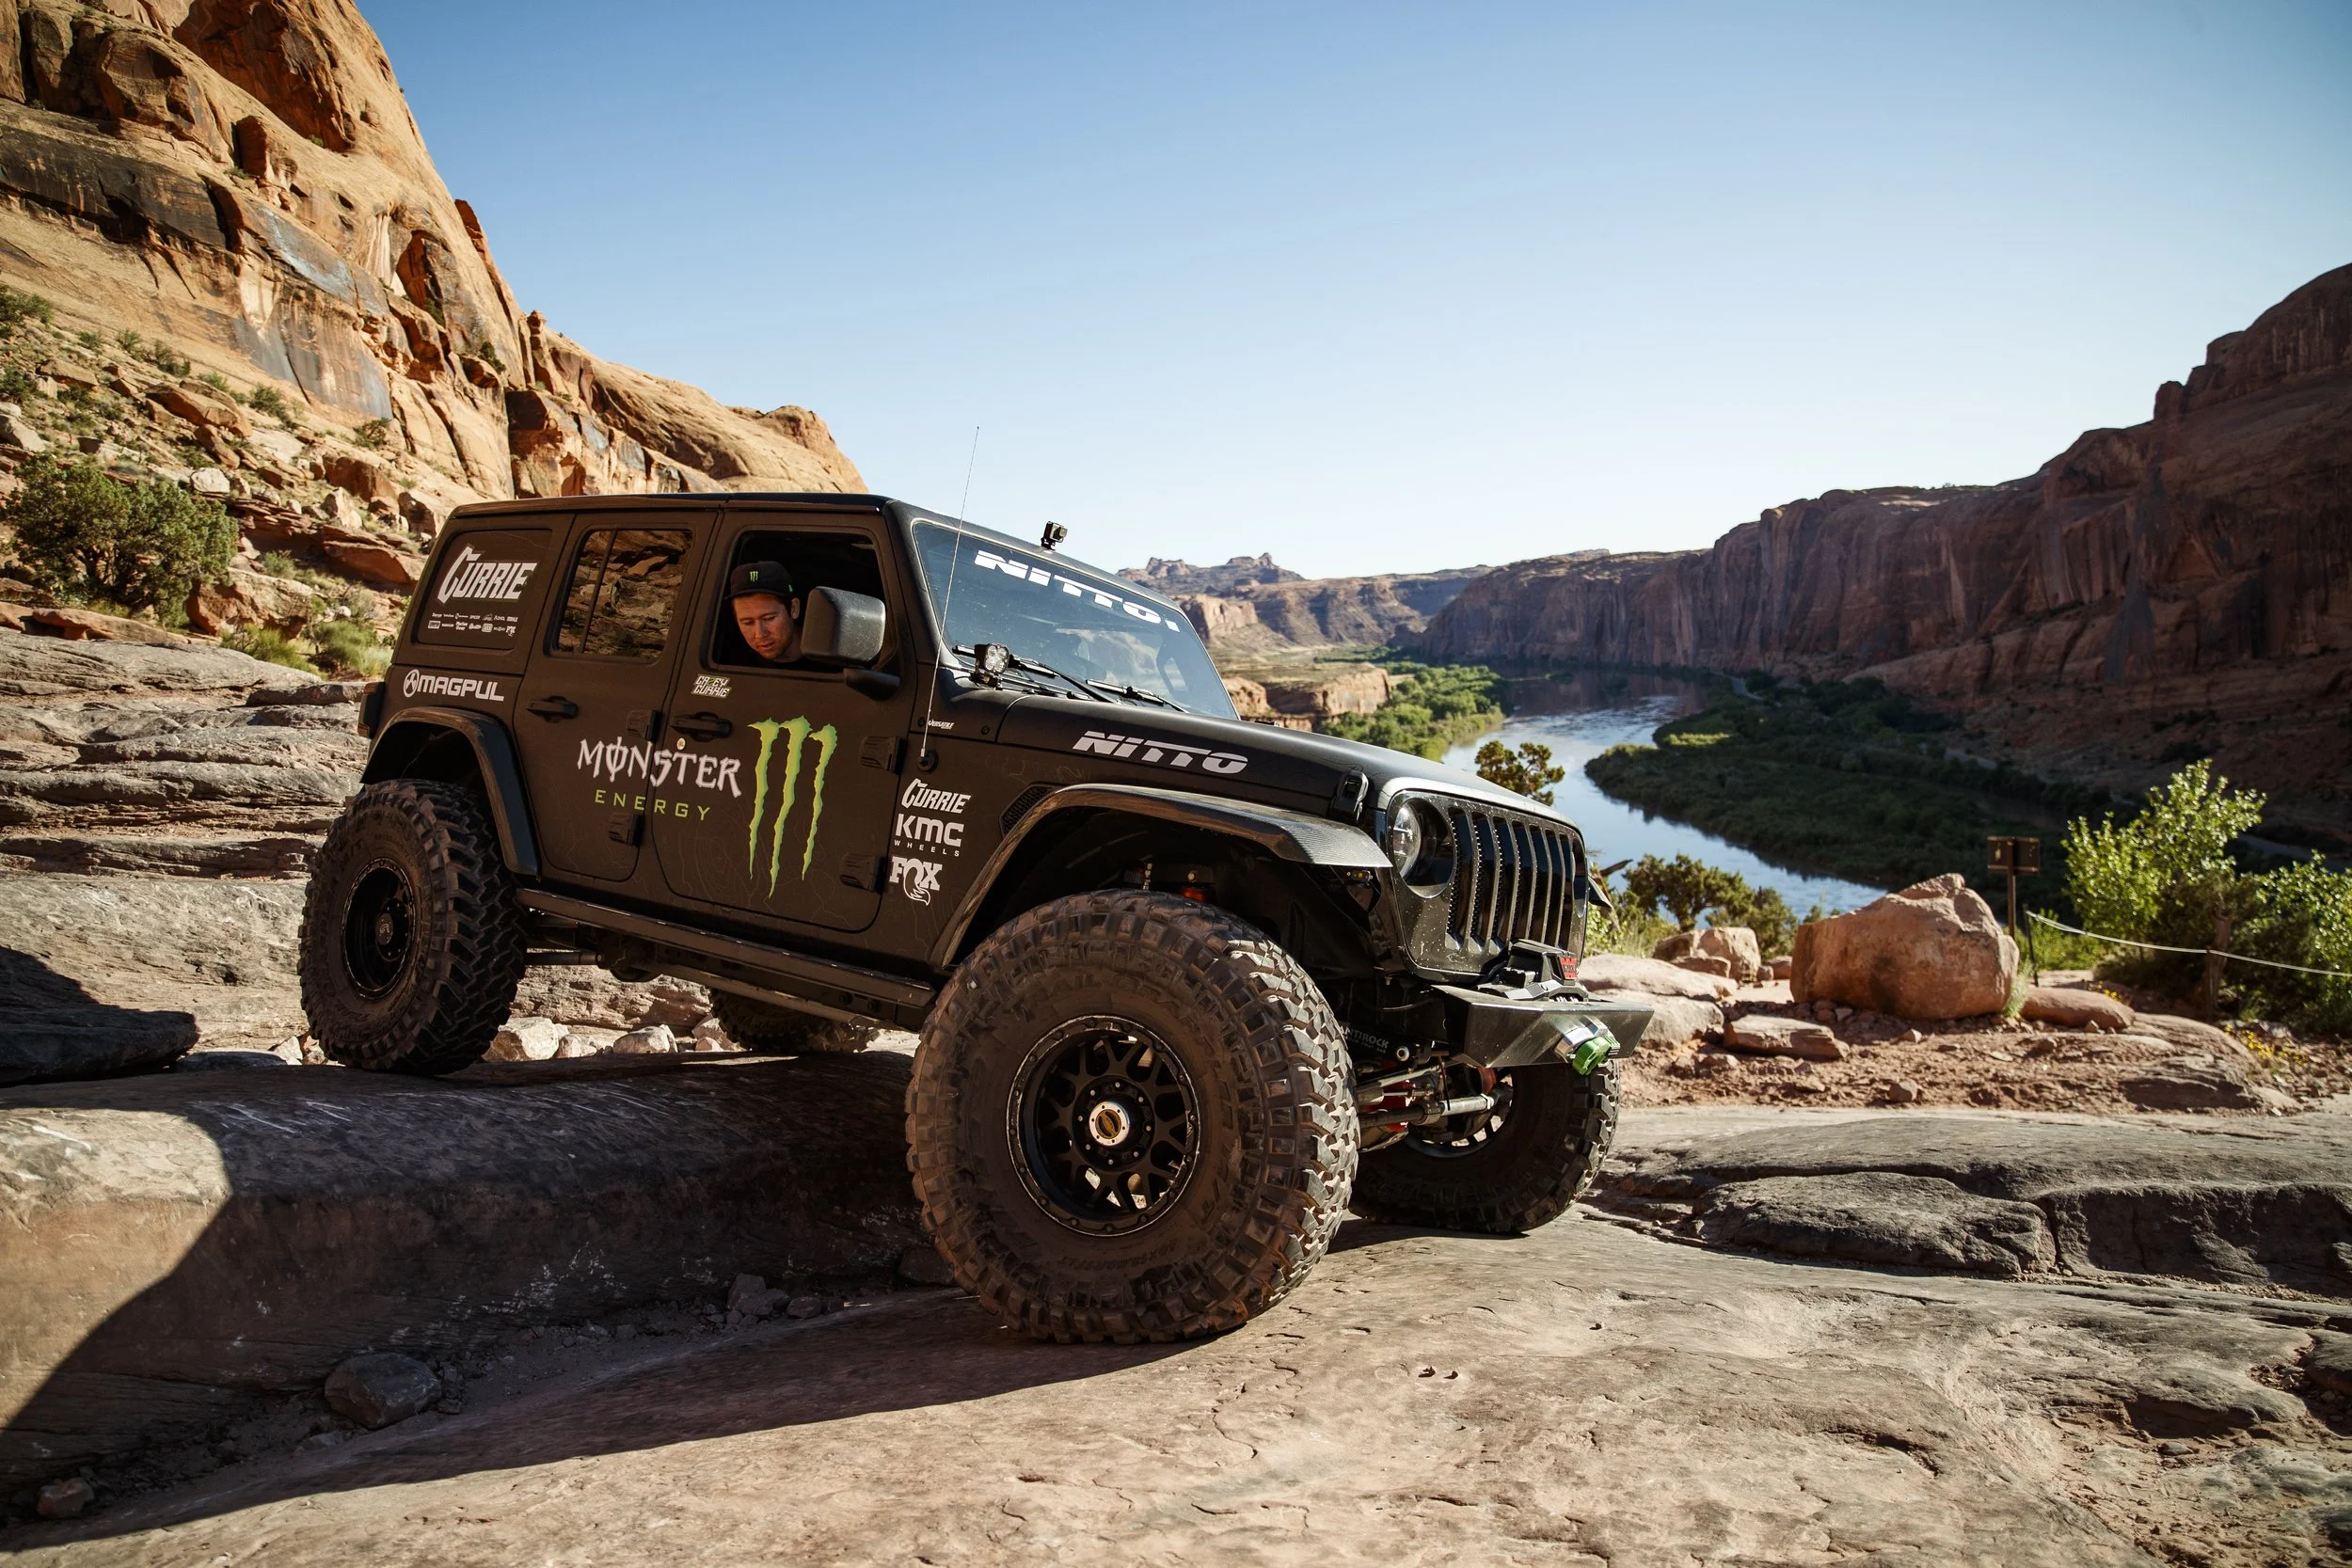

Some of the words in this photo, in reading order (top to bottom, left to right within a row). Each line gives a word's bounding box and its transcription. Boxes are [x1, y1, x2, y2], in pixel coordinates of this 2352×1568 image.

[437, 546, 538, 604] CURRIE
[974, 549, 1162, 625] NITTO
[417, 674, 504, 702] MAGPUL
[692, 684, 731, 698] CURRIE
[577, 736, 742, 799] MONSTER
[1073, 730, 1248, 774] NITTO
[595, 789, 710, 821] ENERGY
[901, 778, 972, 815] CURRIE
[894, 839, 961, 857] WHEELS
[889, 856, 944, 904] FOX
